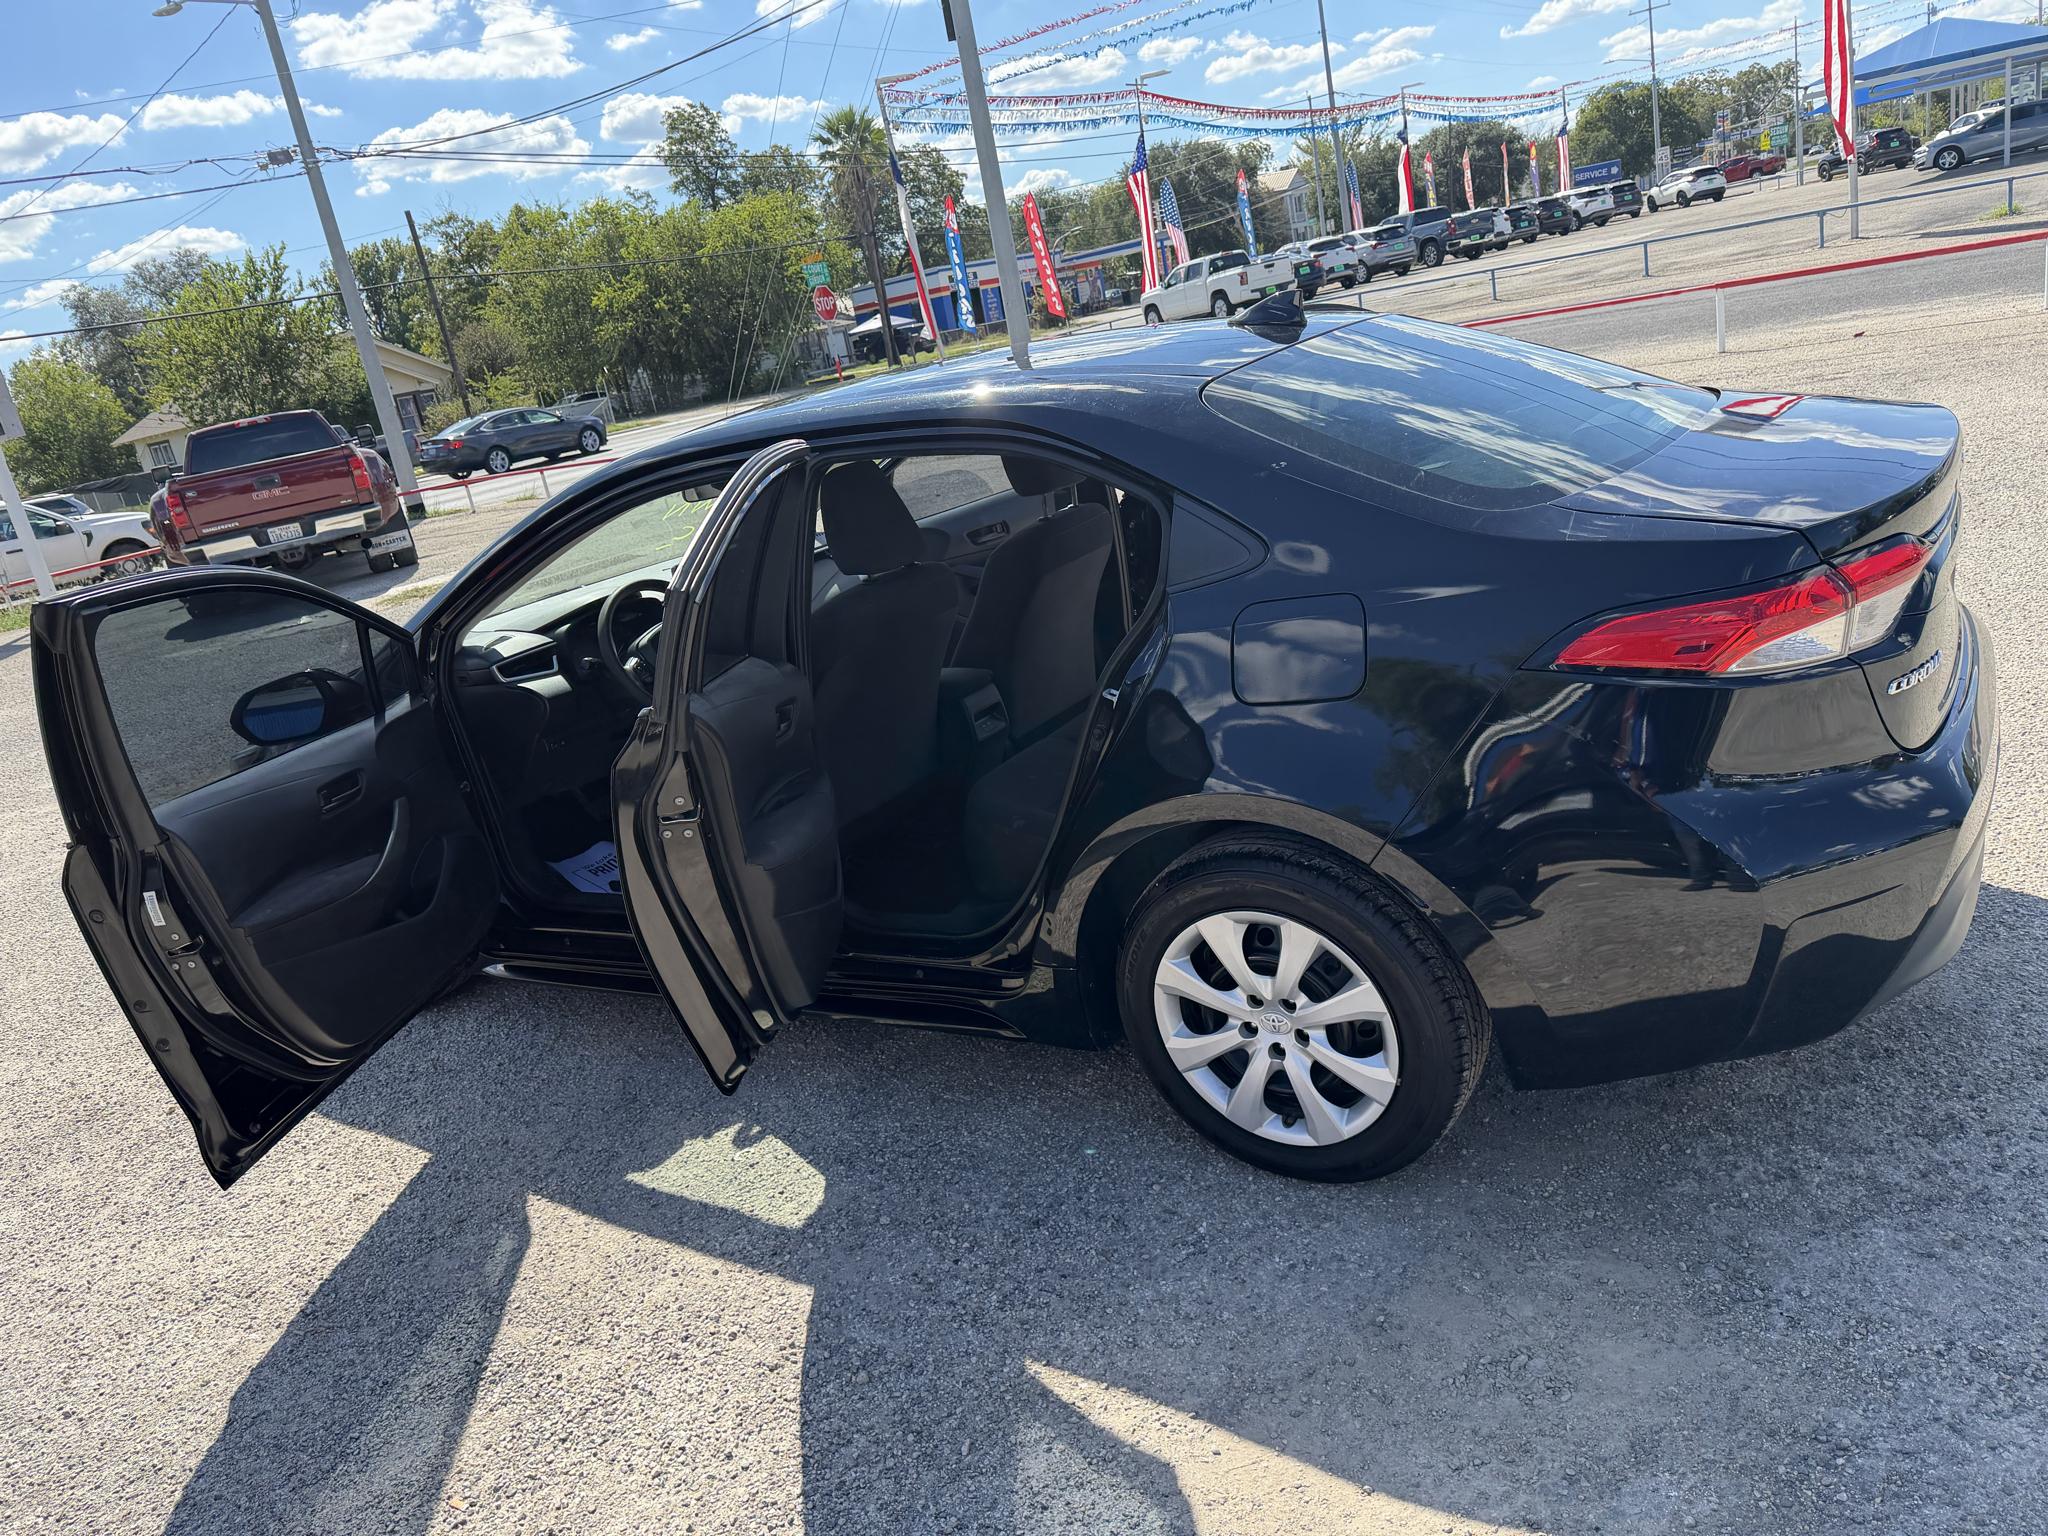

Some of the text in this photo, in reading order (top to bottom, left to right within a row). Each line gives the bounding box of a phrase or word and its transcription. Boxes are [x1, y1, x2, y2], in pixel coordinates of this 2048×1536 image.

[1575, 168, 1609, 181] SERVICE
[816, 297, 835, 311] STOP
[252, 486, 291, 501] GMC
[202, 522, 240, 534] SIERRA
[588, 855, 618, 877] PRID
